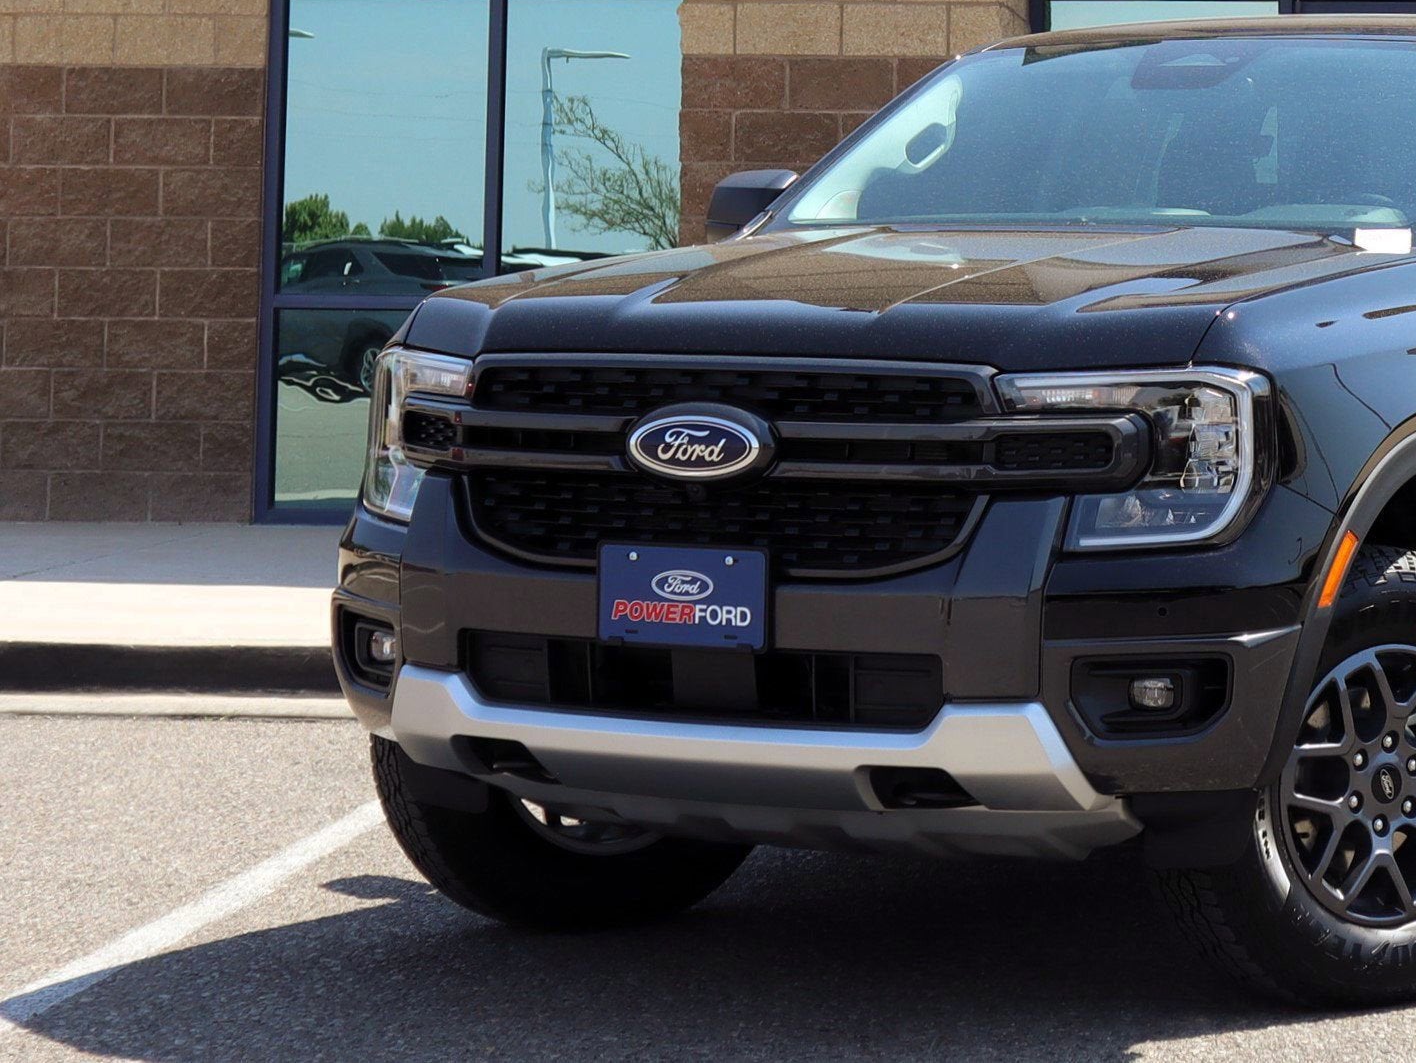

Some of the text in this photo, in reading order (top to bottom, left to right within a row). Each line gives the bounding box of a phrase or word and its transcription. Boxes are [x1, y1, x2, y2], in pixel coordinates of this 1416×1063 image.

[657, 428, 726, 462] Ford
[664, 576, 700, 594] Ford
[612, 599, 751, 627] POWERFORD
